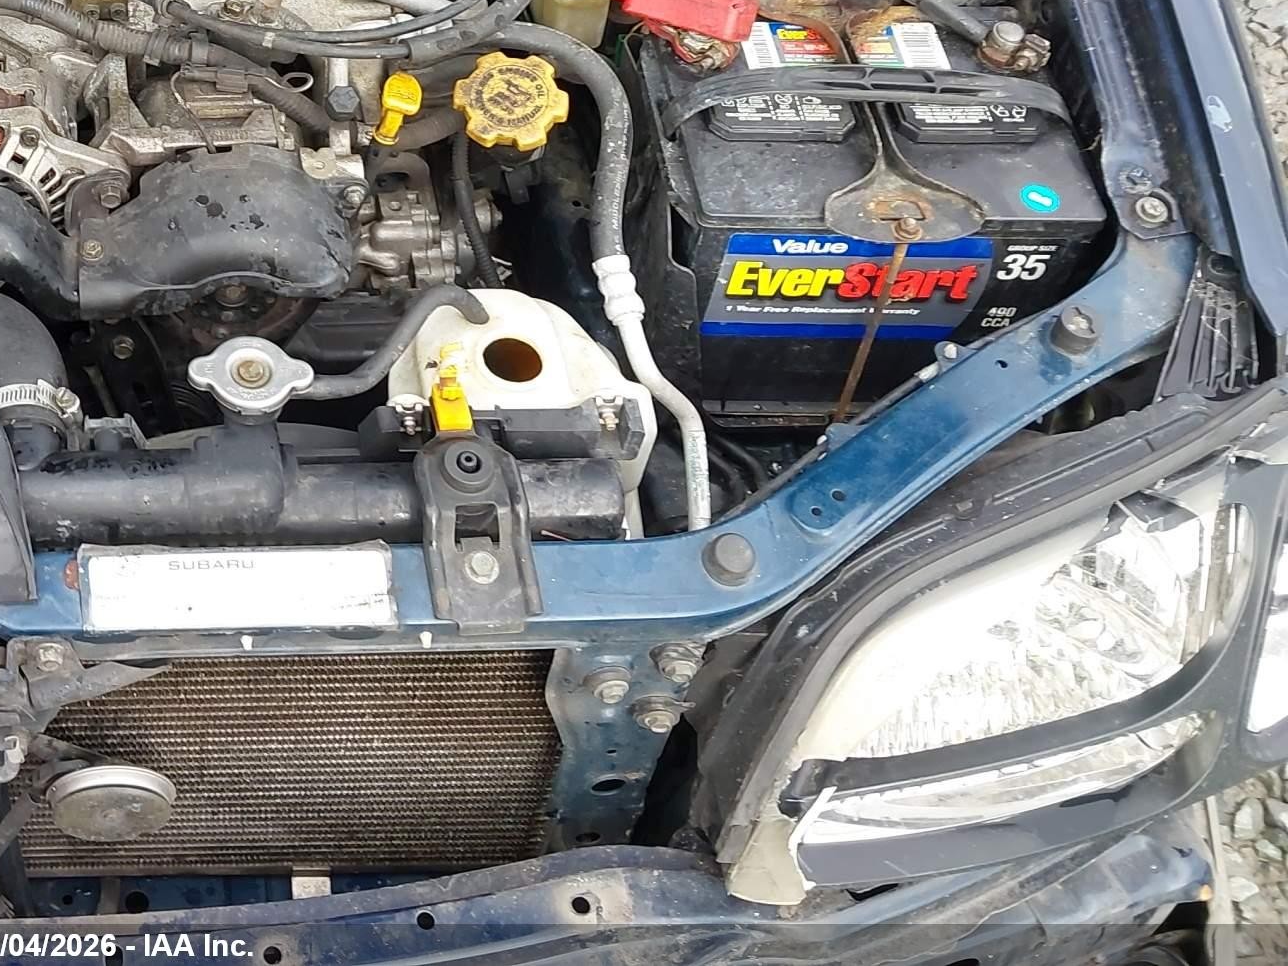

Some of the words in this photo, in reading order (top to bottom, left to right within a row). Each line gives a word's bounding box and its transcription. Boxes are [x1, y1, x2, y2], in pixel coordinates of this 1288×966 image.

[535, 83, 545, 99] OIL
[772, 238, 849, 255] Value
[995, 253, 1052, 281] 35
[725, 260, 979, 302] EverStart
[736, 305, 762, 313] Year
[762, 306, 790, 314] Free
[791, 306, 868, 315] Replacement
[980, 317, 1011, 328] CCA
[168, 558, 255, 571] SUBARU
